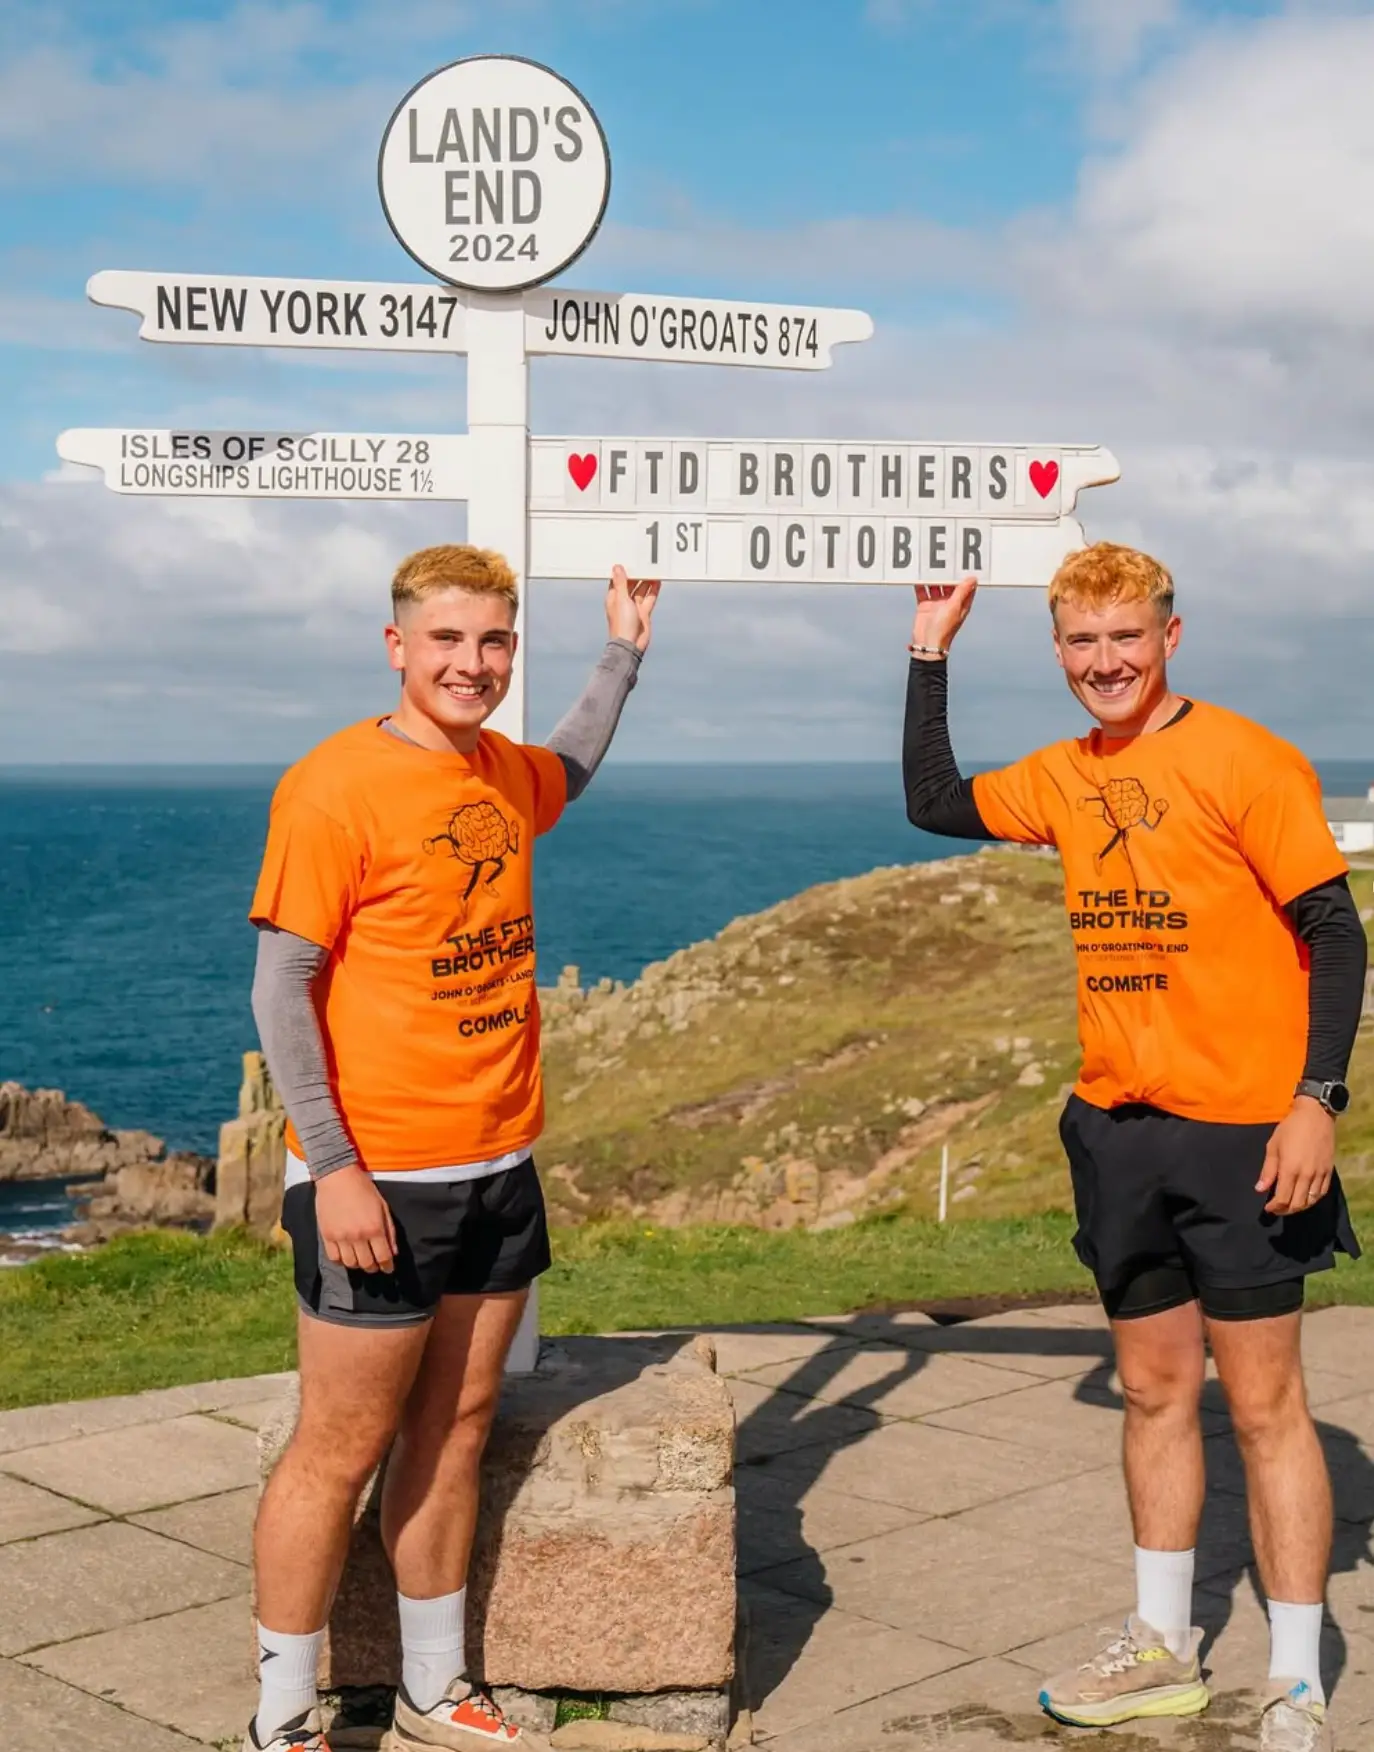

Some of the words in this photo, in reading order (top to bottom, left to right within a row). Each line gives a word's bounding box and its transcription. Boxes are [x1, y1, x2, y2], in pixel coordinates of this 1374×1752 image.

[409, 106, 583, 164] LAND'S
[445, 169, 542, 225] END
[448, 234, 539, 262] 2024
[156, 285, 248, 333] NEW
[260, 289, 368, 337] YORK
[379, 295, 458, 339] 3147
[545, 298, 620, 345] JOHN
[630, 304, 769, 356] O'GROATS
[778, 316, 819, 358] 874
[121, 434, 212, 460] ISLES
[222, 437, 265, 461] OF
[276, 437, 386, 463] SCILLY
[396, 440, 430, 464] 28
[121, 463, 250, 490] LONGSHIPS
[258, 466, 402, 492] LIGHTHOUSE
[609, 450, 699, 495] FTD
[738, 452, 1008, 500] BROTHERS
[749, 525, 983, 571] OCTOBER
[1078, 889, 1128, 908] THE
[446, 927, 496, 953] THE
[501, 914, 534, 940] FTD
[1166, 944, 1189, 953] END
[431, 936, 535, 978] BROTHER
[431, 988, 463, 1001] JOHN
[510, 969, 534, 983] LAND
